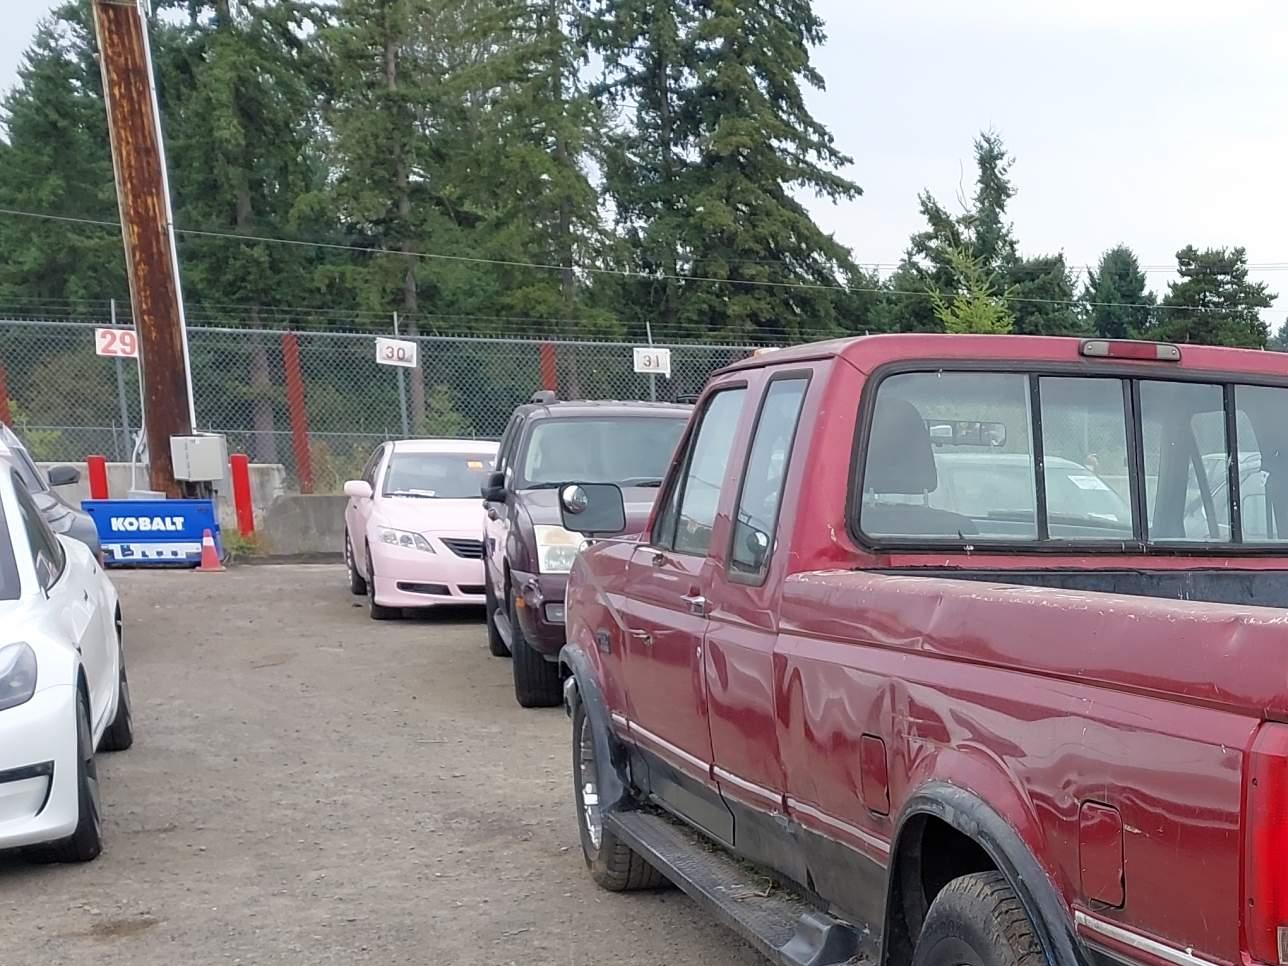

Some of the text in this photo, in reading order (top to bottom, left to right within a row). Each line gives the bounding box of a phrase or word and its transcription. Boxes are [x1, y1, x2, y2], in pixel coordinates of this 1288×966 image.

[100, 330, 136, 355] 29
[385, 345, 406, 361] 30
[643, 355, 660, 368] 31
[110, 516, 185, 532] KOBALT
